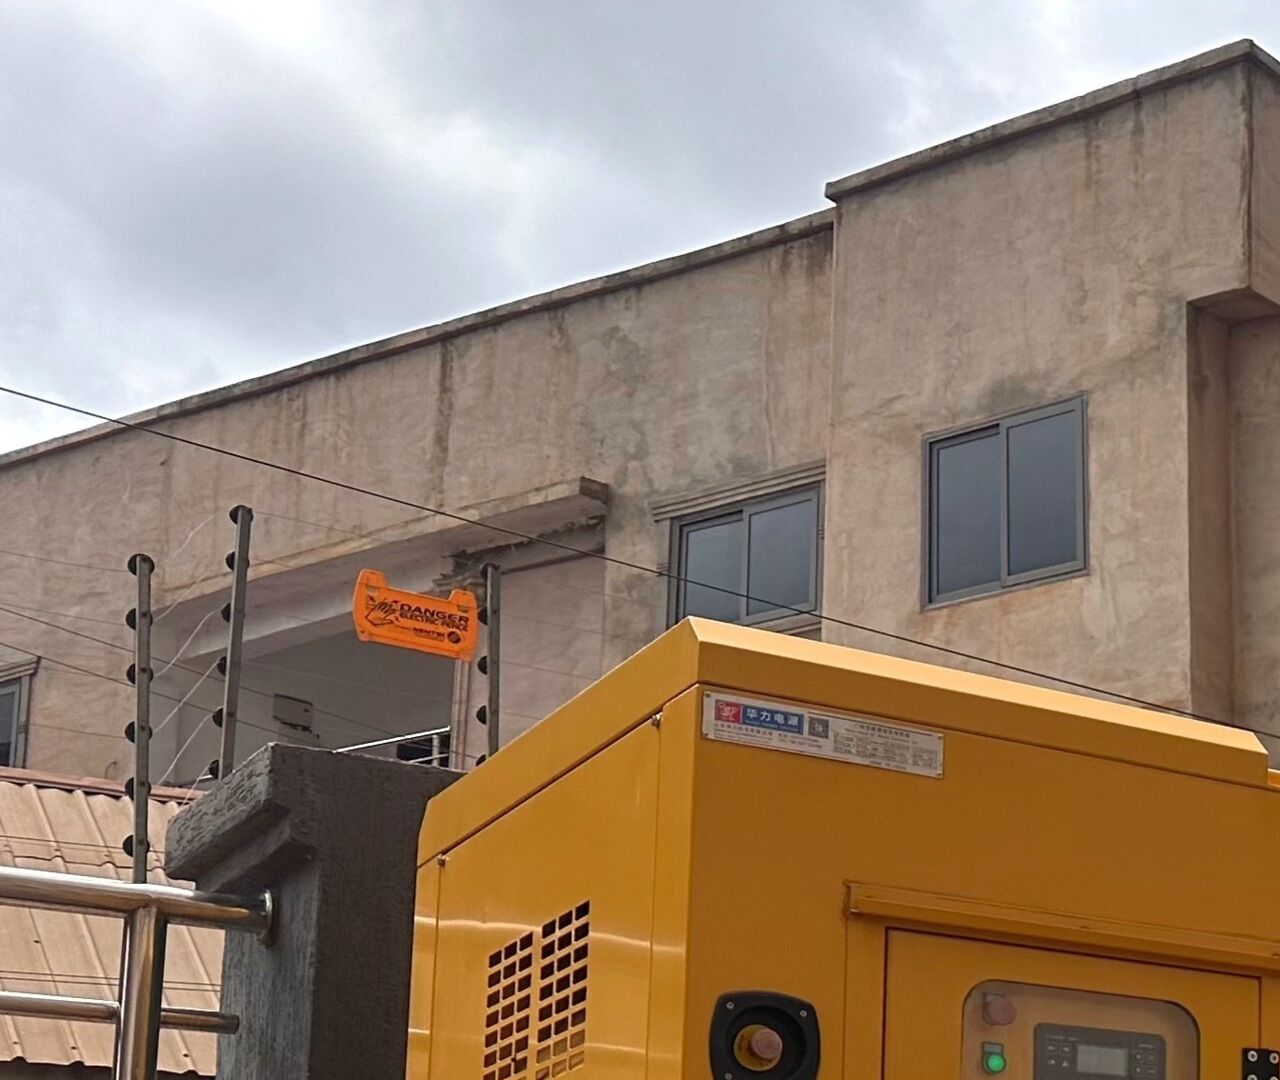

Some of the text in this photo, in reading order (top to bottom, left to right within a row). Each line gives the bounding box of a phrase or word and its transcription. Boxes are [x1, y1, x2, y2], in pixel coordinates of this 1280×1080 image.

[400, 603, 469, 624] DANGER
[400, 609, 469, 632] ELECTRIC FENCE
[746, 708, 799, 727] 华力电源
